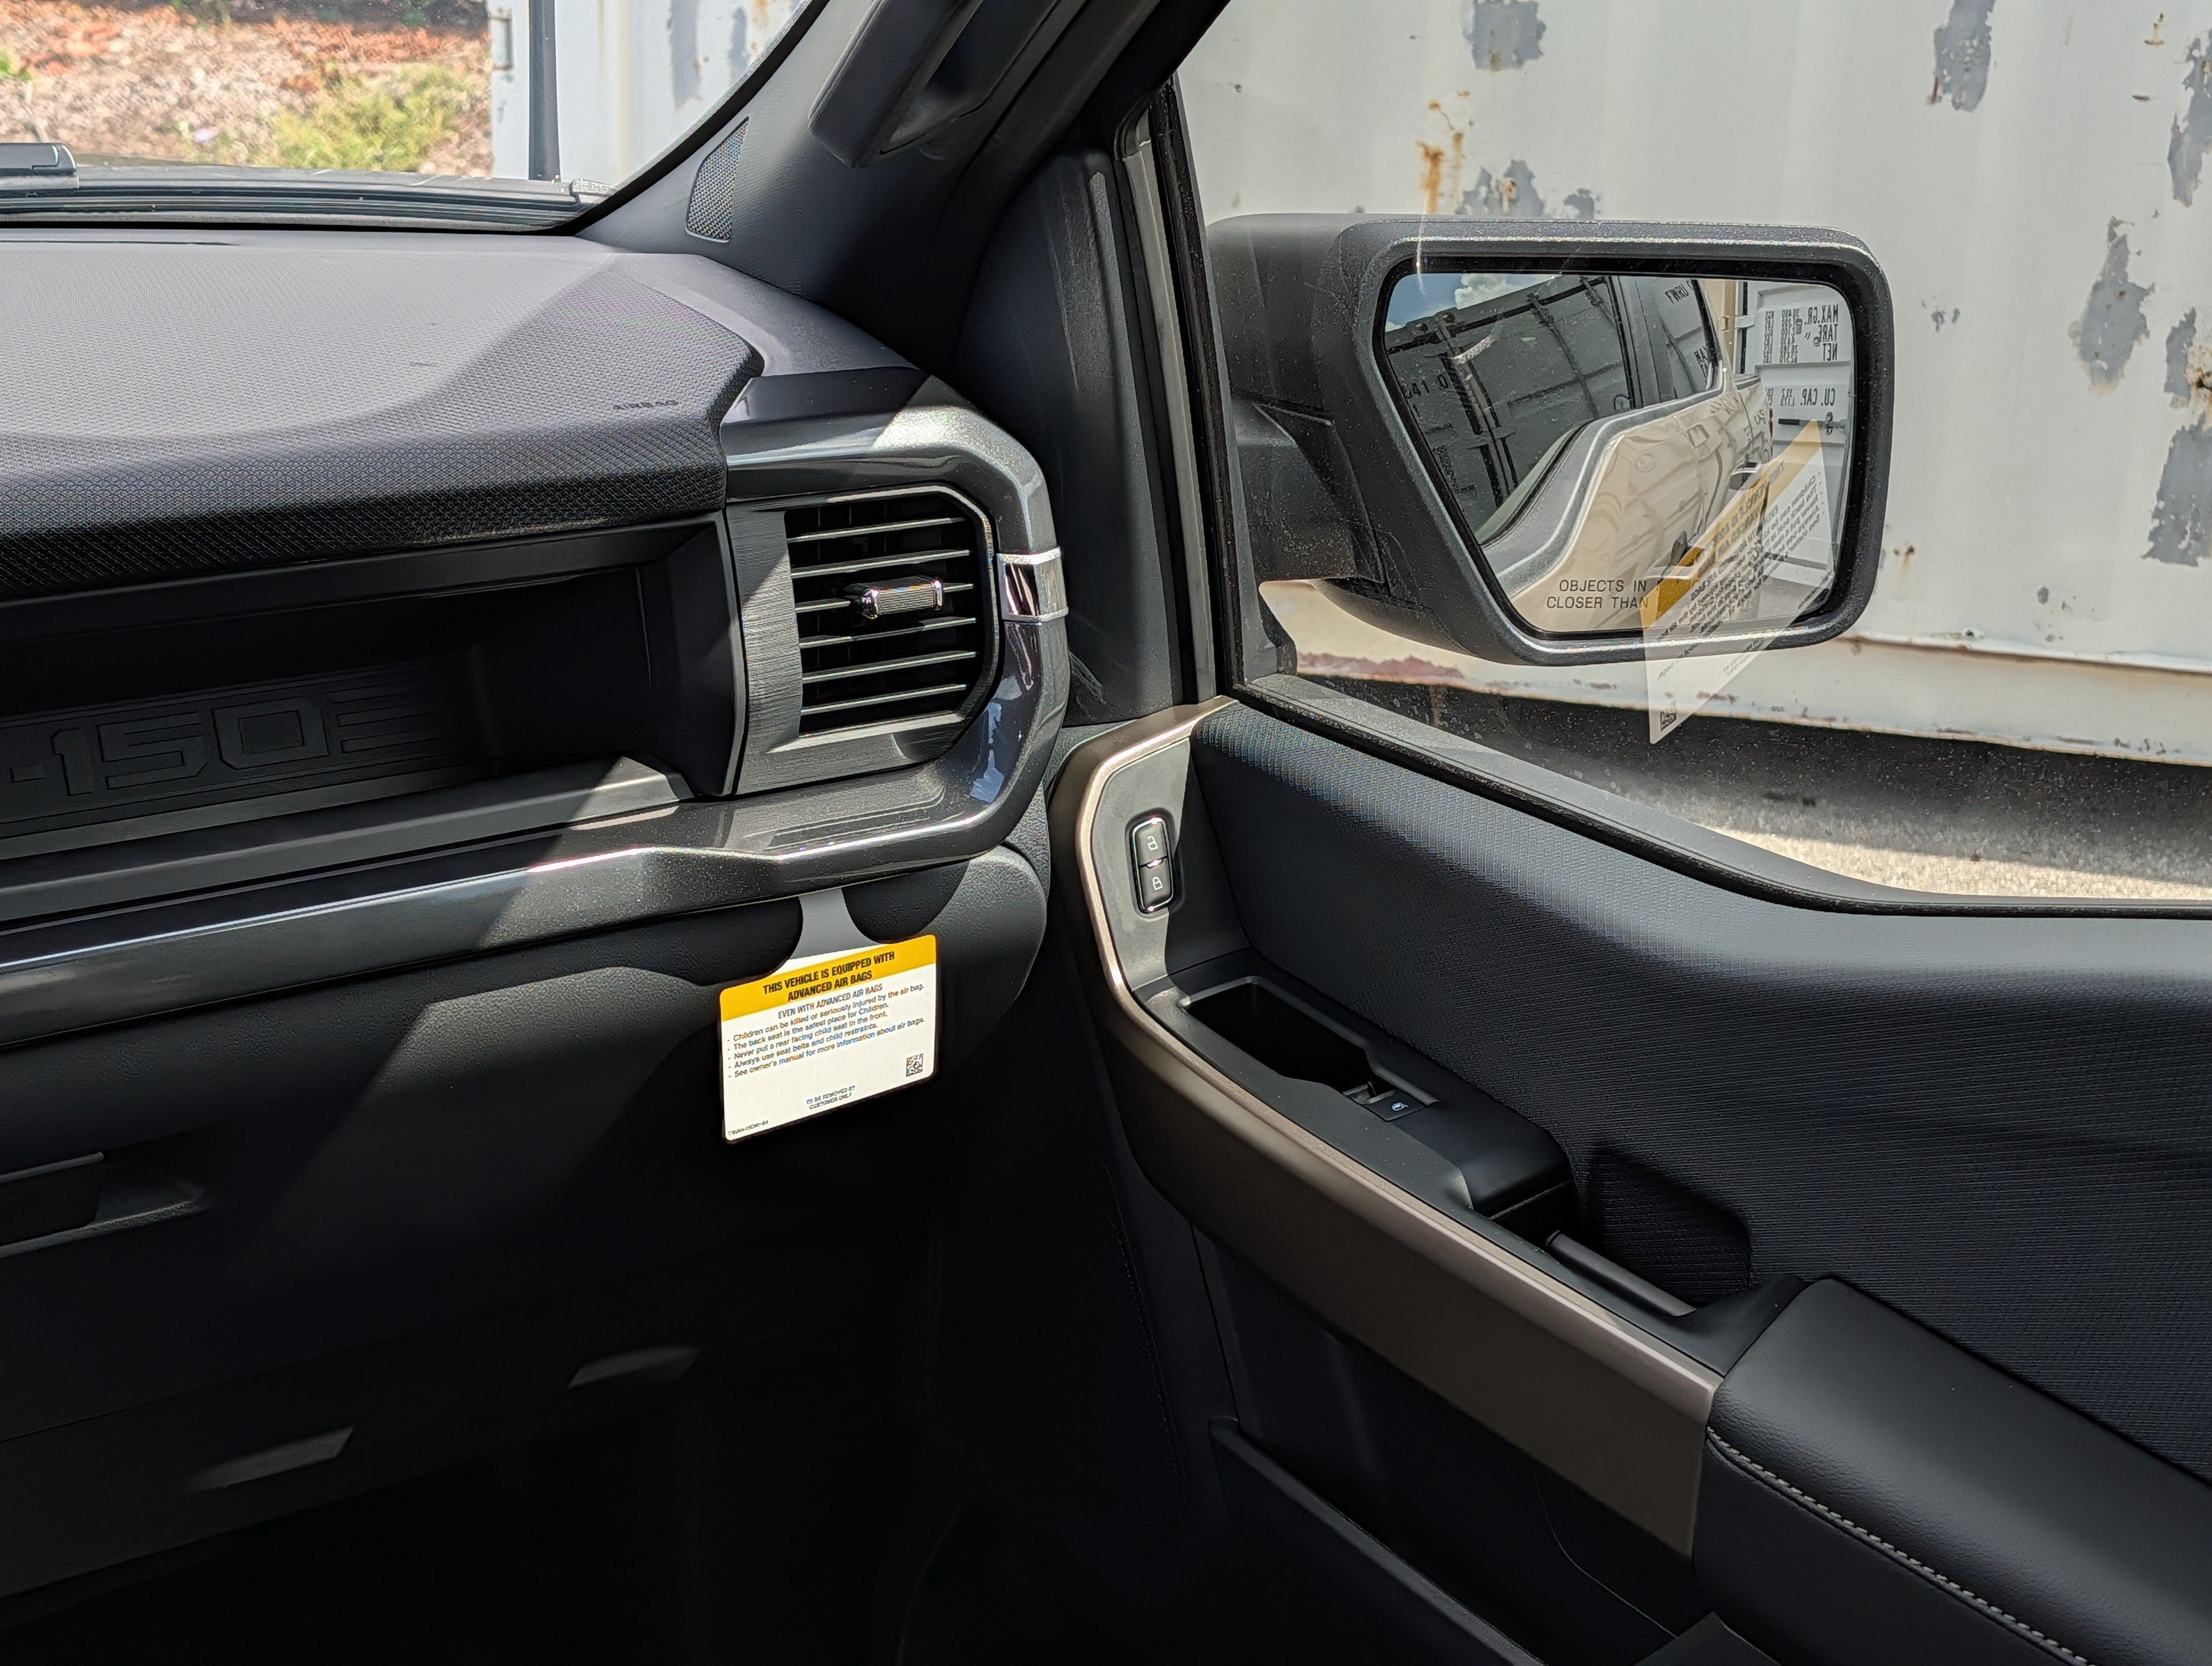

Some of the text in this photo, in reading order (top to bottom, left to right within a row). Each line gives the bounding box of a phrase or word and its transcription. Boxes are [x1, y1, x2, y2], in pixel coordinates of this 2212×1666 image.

[613, 400, 678, 411] AIRBAG
[1547, 597, 1649, 608] CLOSER THAN
[1559, 579, 1624, 592] OBJECTS
[1634, 580, 1647, 592] IN
[763, 951, 894, 995] THIS VEHICLE IS EQUIPPED WITH
[788, 970, 872, 1001] ADVANCED AIR BAGS
[733, 1029, 763, 1042] Children
[765, 1024, 778, 1033] can
[790, 1015, 808, 1026] killed
[820, 1004, 850, 1018] seriously
[900, 986, 909, 995] air
[910, 984, 924, 992] bag.
[778, 983, 882, 1019] EVEN WITH ADVANCED AIR BAGS
[734, 1042, 747, 1050] The
[749, 1036, 766, 1046] back
[827, 1014, 846, 1025] place
[734, 1049, 754, 1060] Never
[756, 1044, 768, 1054] put
[775, 1039, 789, 1048] rear
[792, 1033, 813, 1043] facing
[814, 1026, 831, 1036] child
[833, 1022, 847, 1031] seat
[734, 1069, 748, 1078] See
[779, 1052, 804, 1065] manual
[817, 1043, 834, 1053] more
[877, 1024, 895, 1036] about
[897, 1022, 905, 1030] air
[908, 1017, 925, 1027] bags.
[734, 1056, 760, 1069] Always
[761, 1052, 774, 1060] use
[776, 1047, 790, 1056] seat
[811, 1037, 824, 1046] and
[826, 1031, 843, 1042] child
